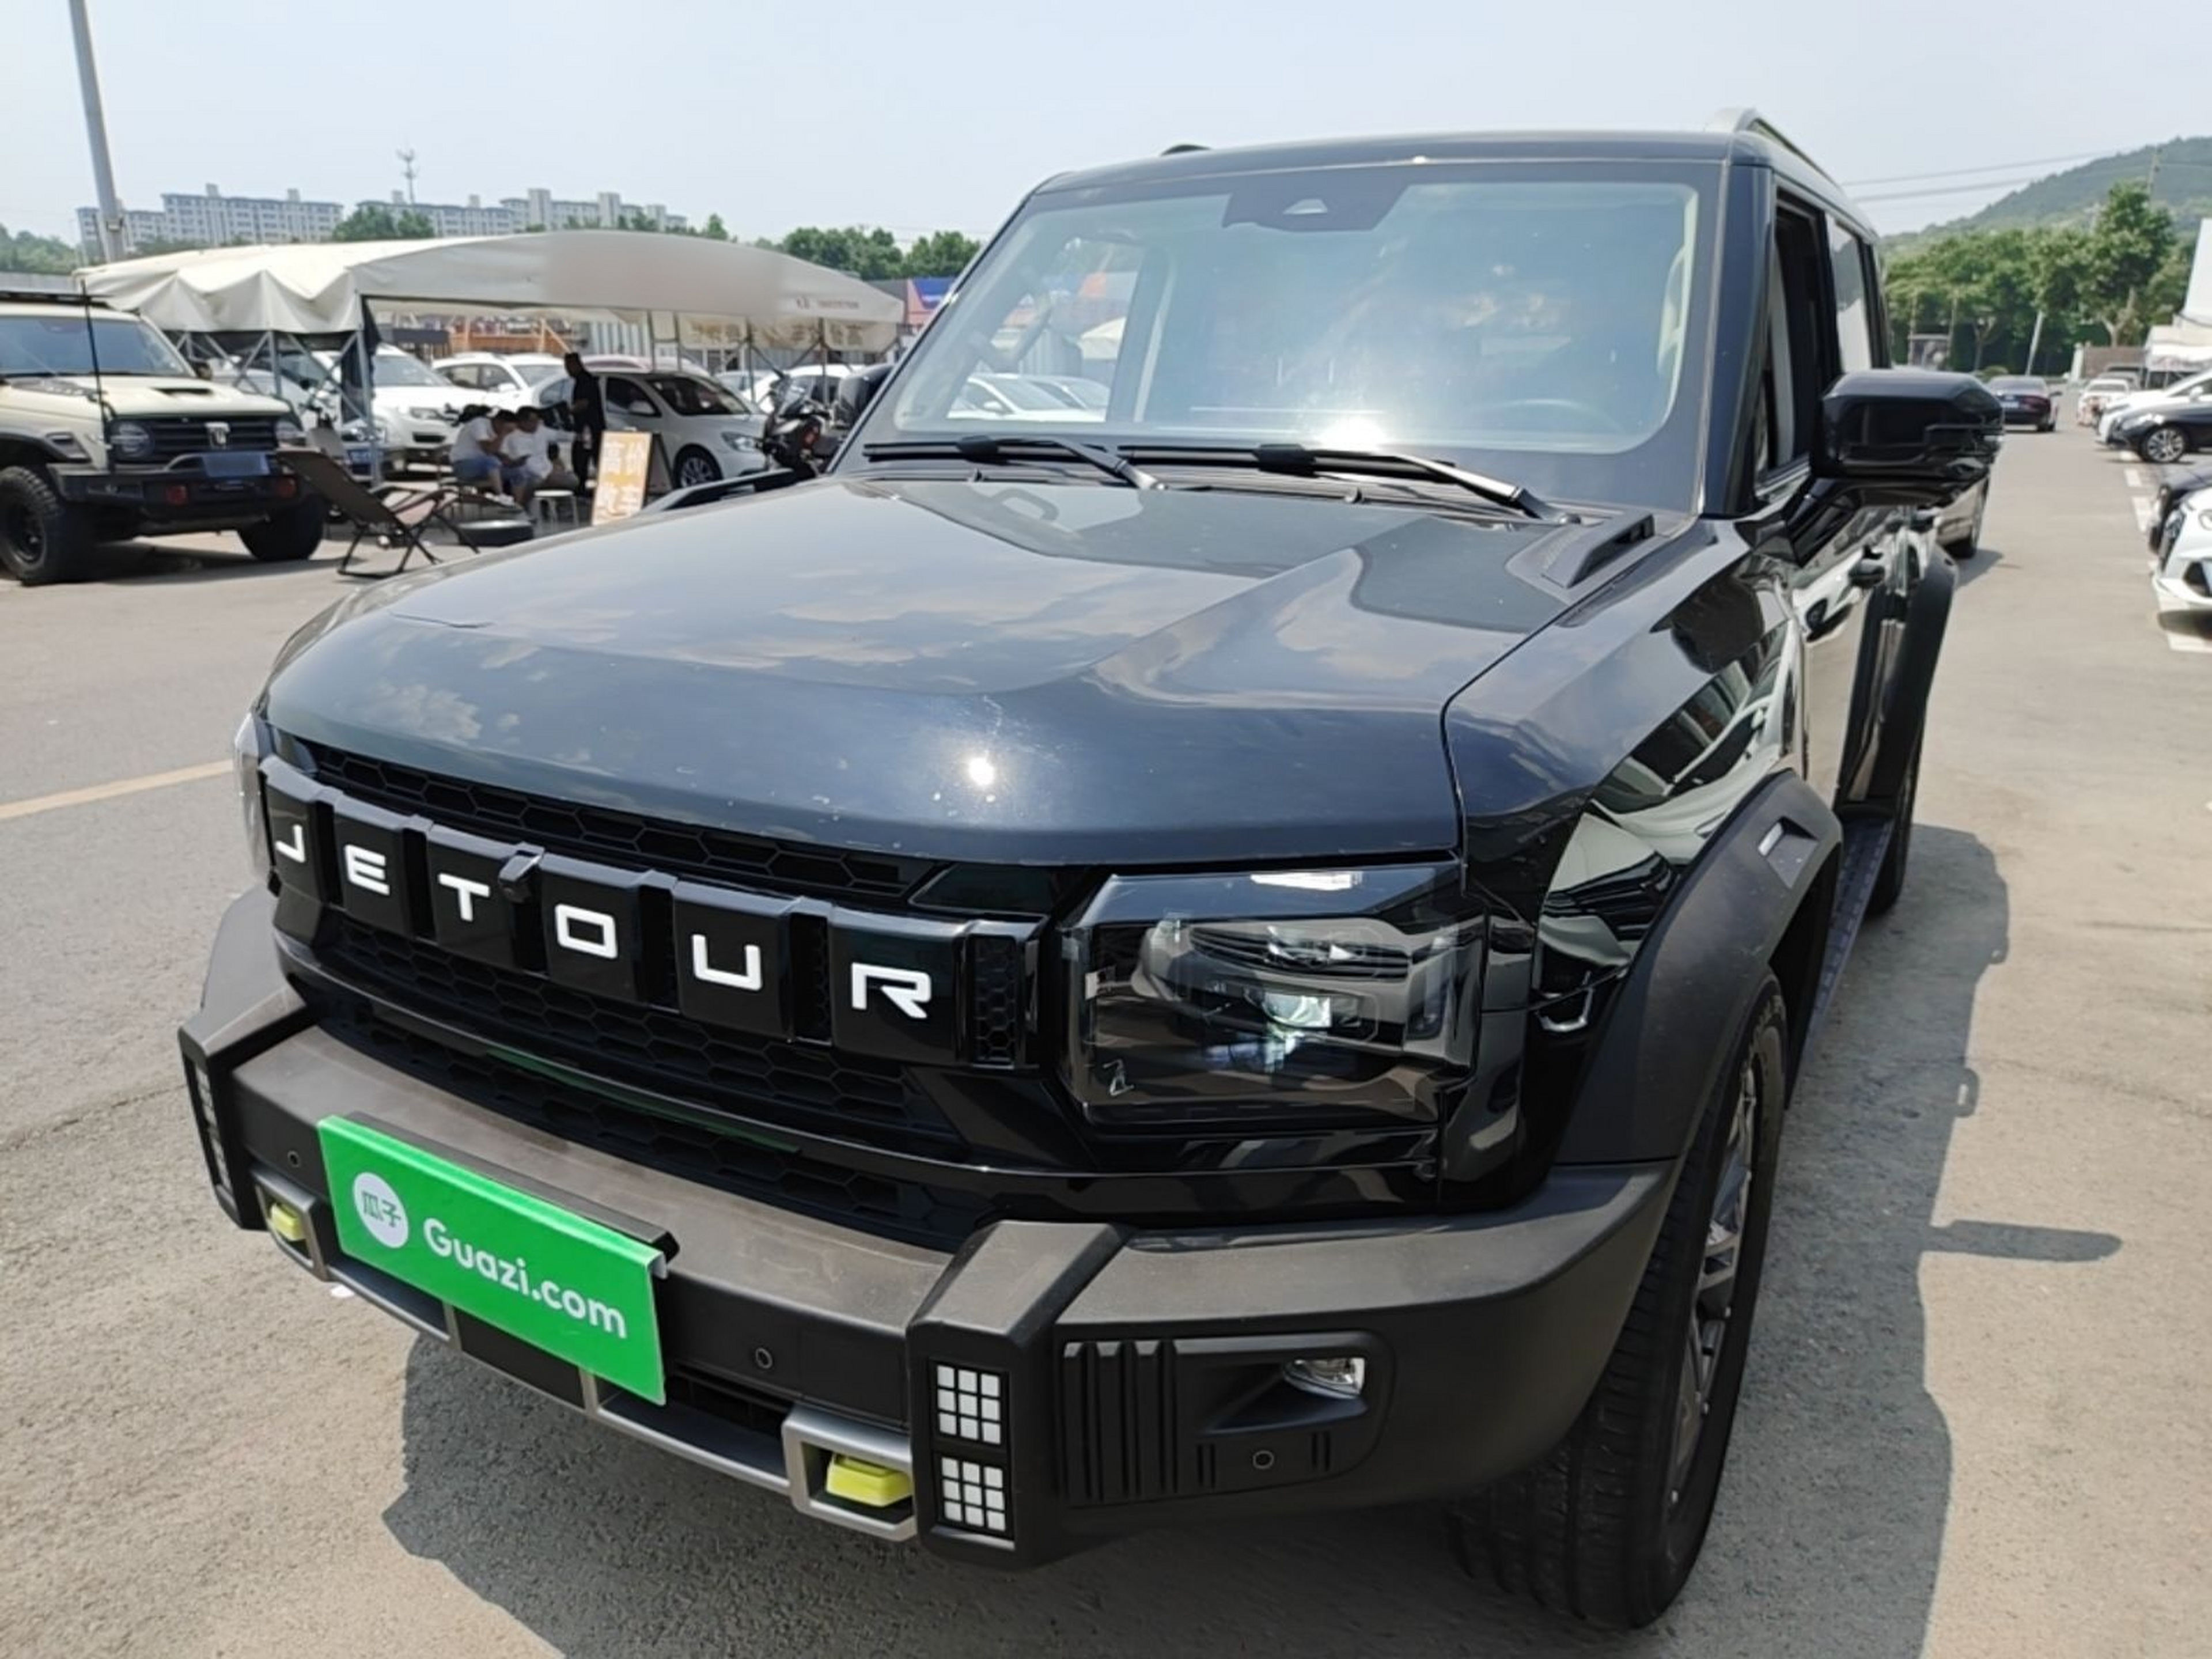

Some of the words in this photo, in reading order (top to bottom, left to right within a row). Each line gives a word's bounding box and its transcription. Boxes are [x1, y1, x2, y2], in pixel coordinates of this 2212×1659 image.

[276, 825, 931, 1019] JETOUR
[362, 1191, 401, 1228] 瓜子
[424, 1218, 627, 1339] Guazi.com
